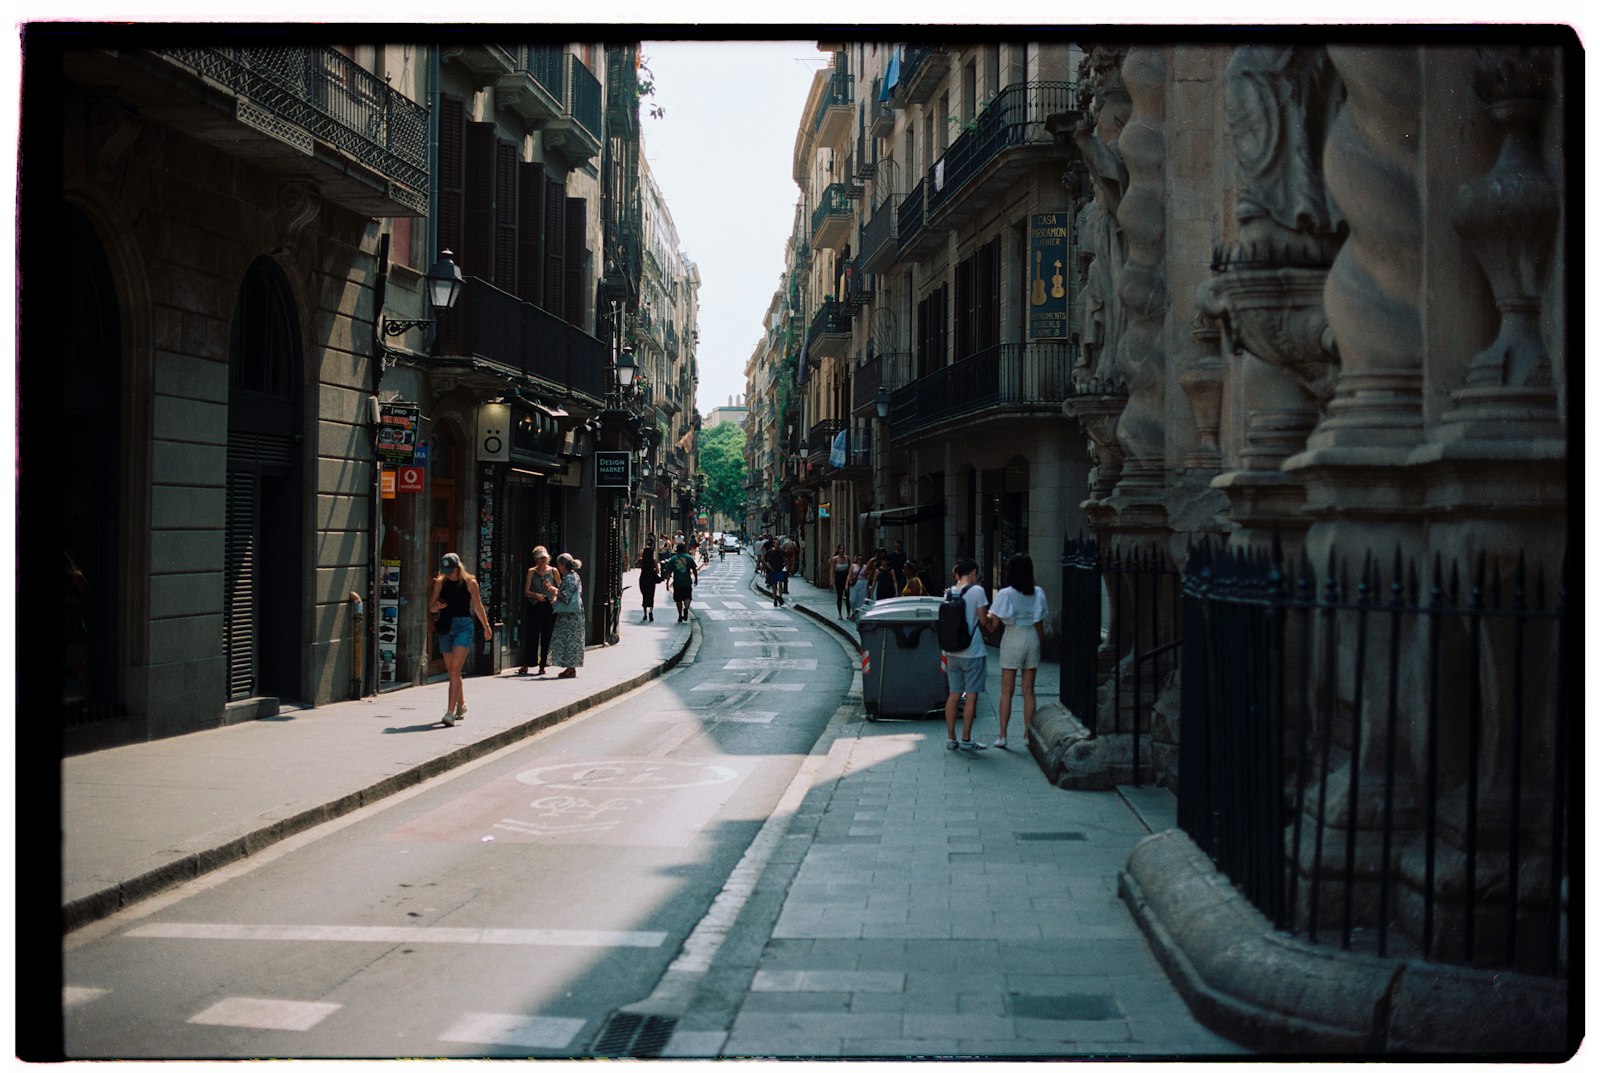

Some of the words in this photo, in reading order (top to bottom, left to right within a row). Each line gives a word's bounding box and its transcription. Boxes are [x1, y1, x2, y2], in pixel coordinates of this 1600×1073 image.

[1038, 214, 1057, 225] CASA
[1031, 226, 1067, 238] PARRAMON
[600, 458, 625, 466] DESIGN
